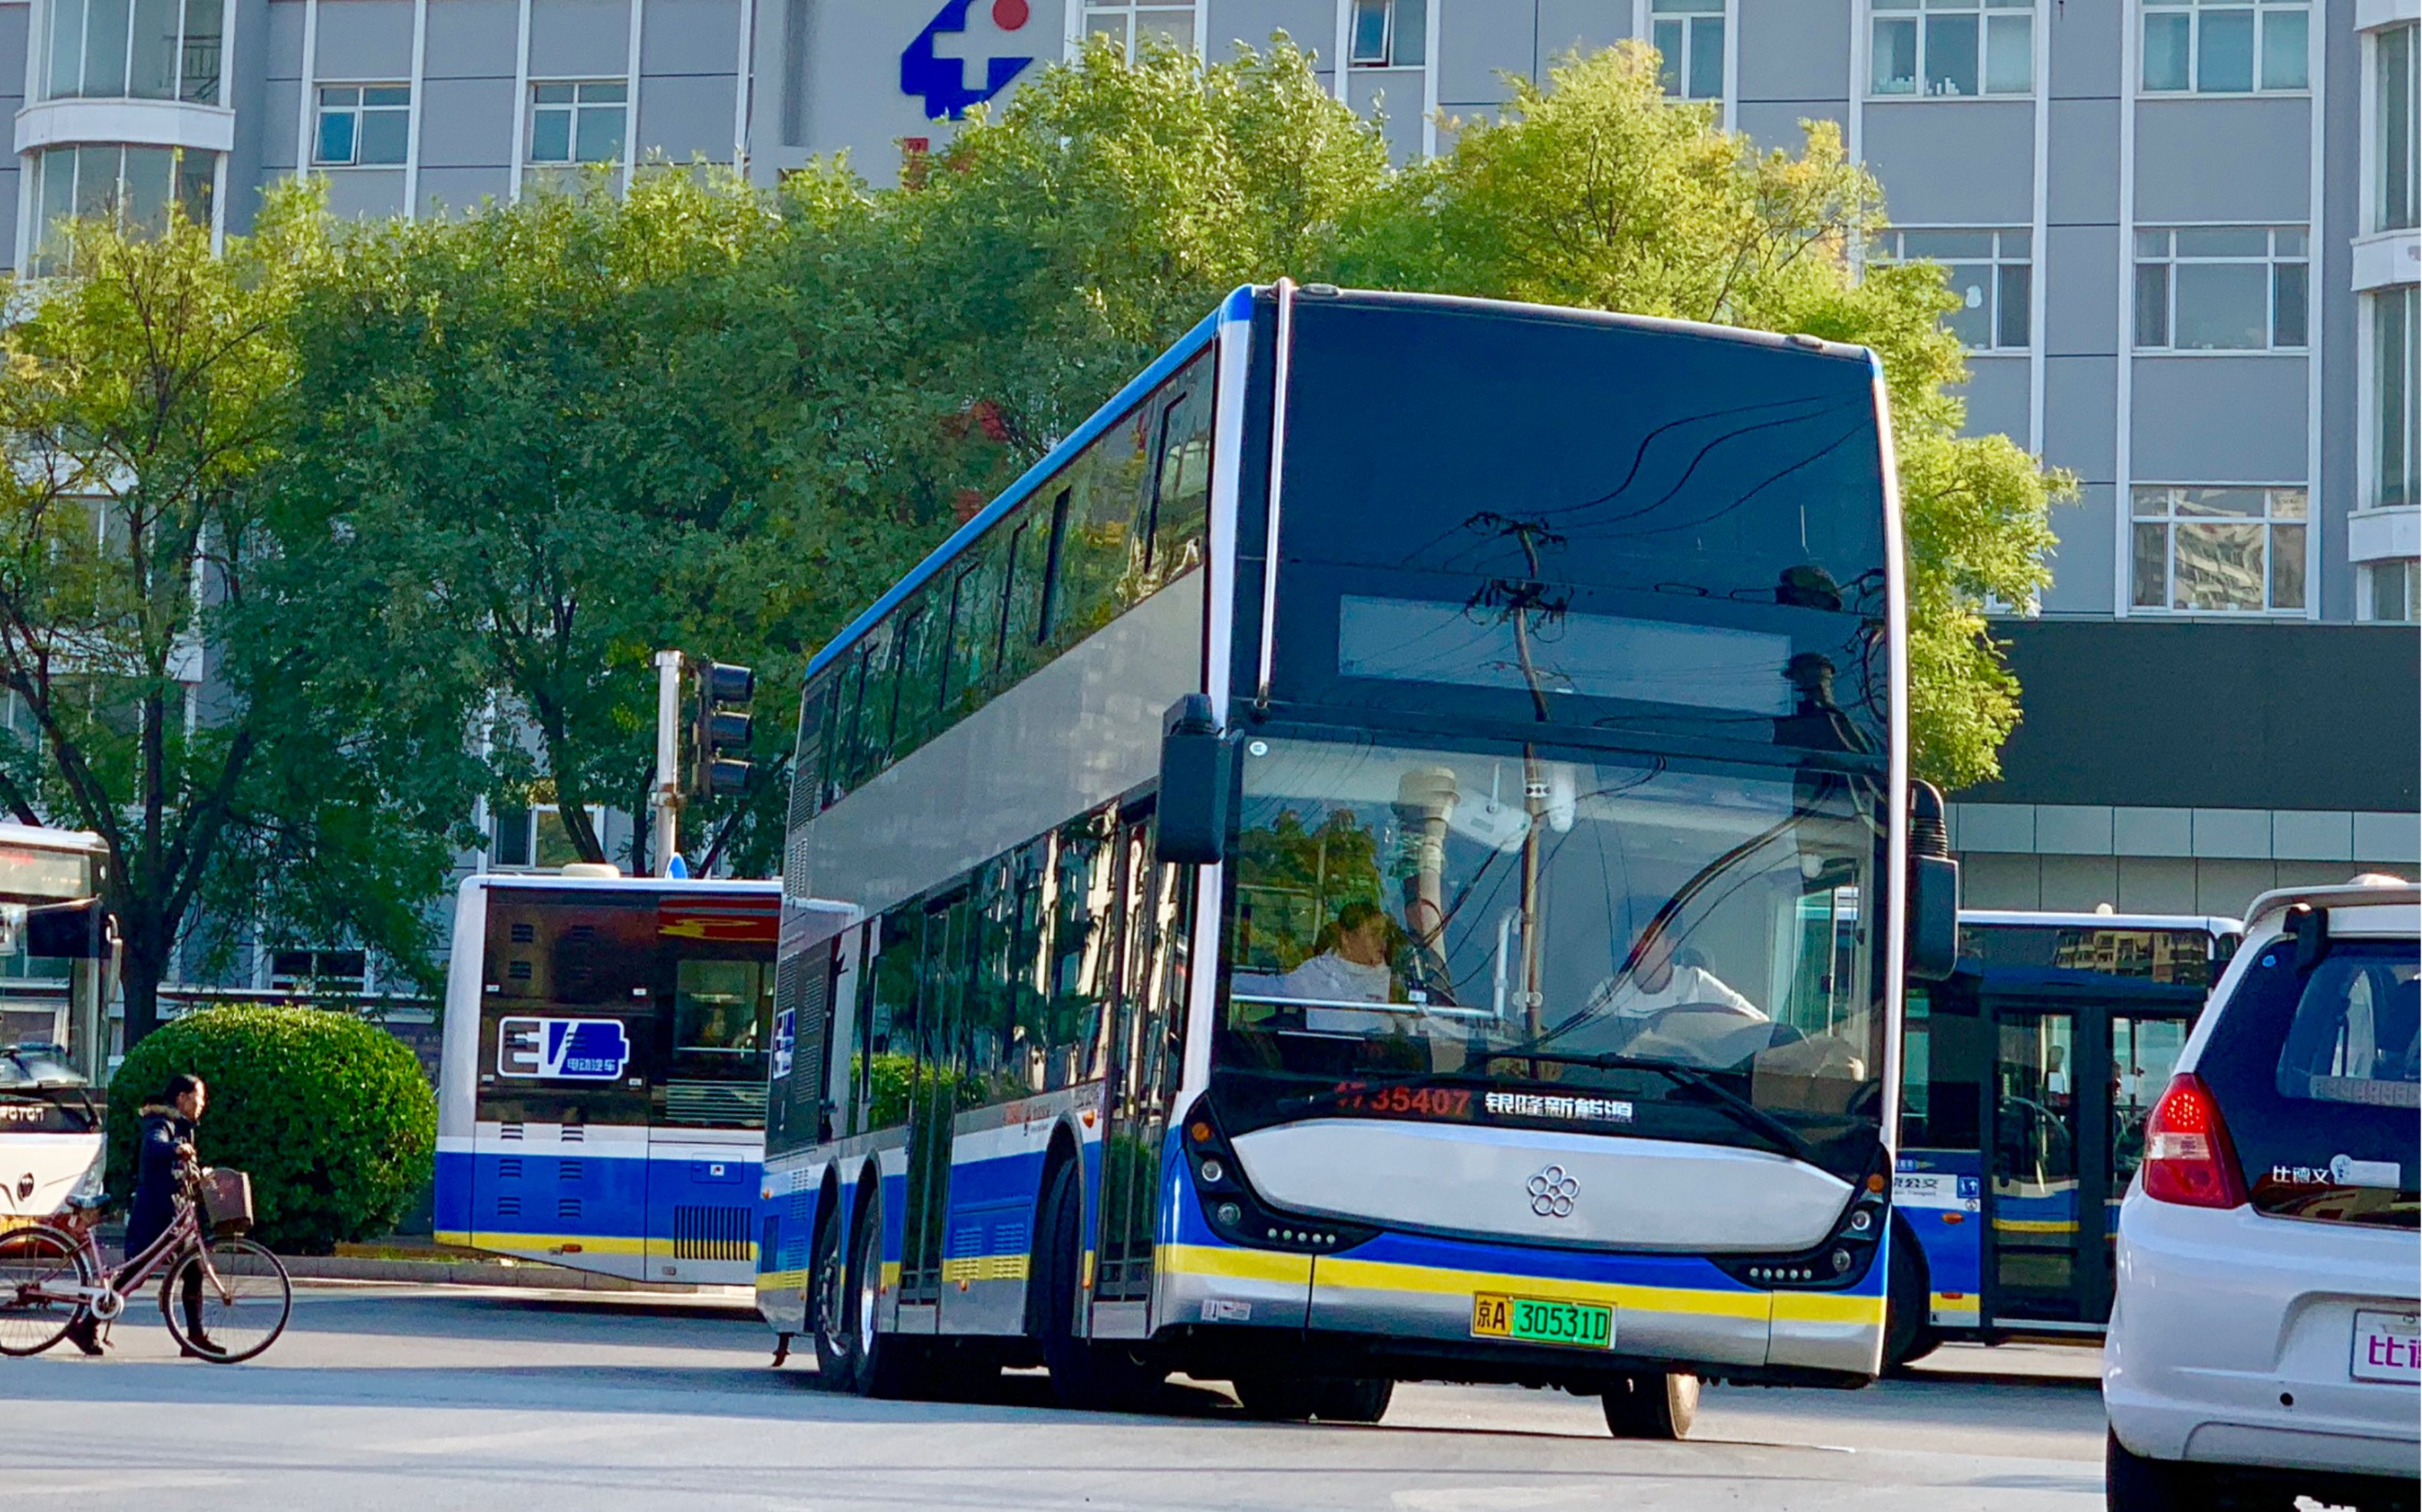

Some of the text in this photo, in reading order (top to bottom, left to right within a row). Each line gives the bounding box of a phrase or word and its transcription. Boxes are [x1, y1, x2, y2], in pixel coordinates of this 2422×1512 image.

[567, 1058, 616, 1072] 电动汽车
[1485, 1092, 1633, 1123] 银隆新能源
[2272, 1165, 2330, 1184] 比德文
[1478, 1300, 1609, 1339] 京A 30531D
